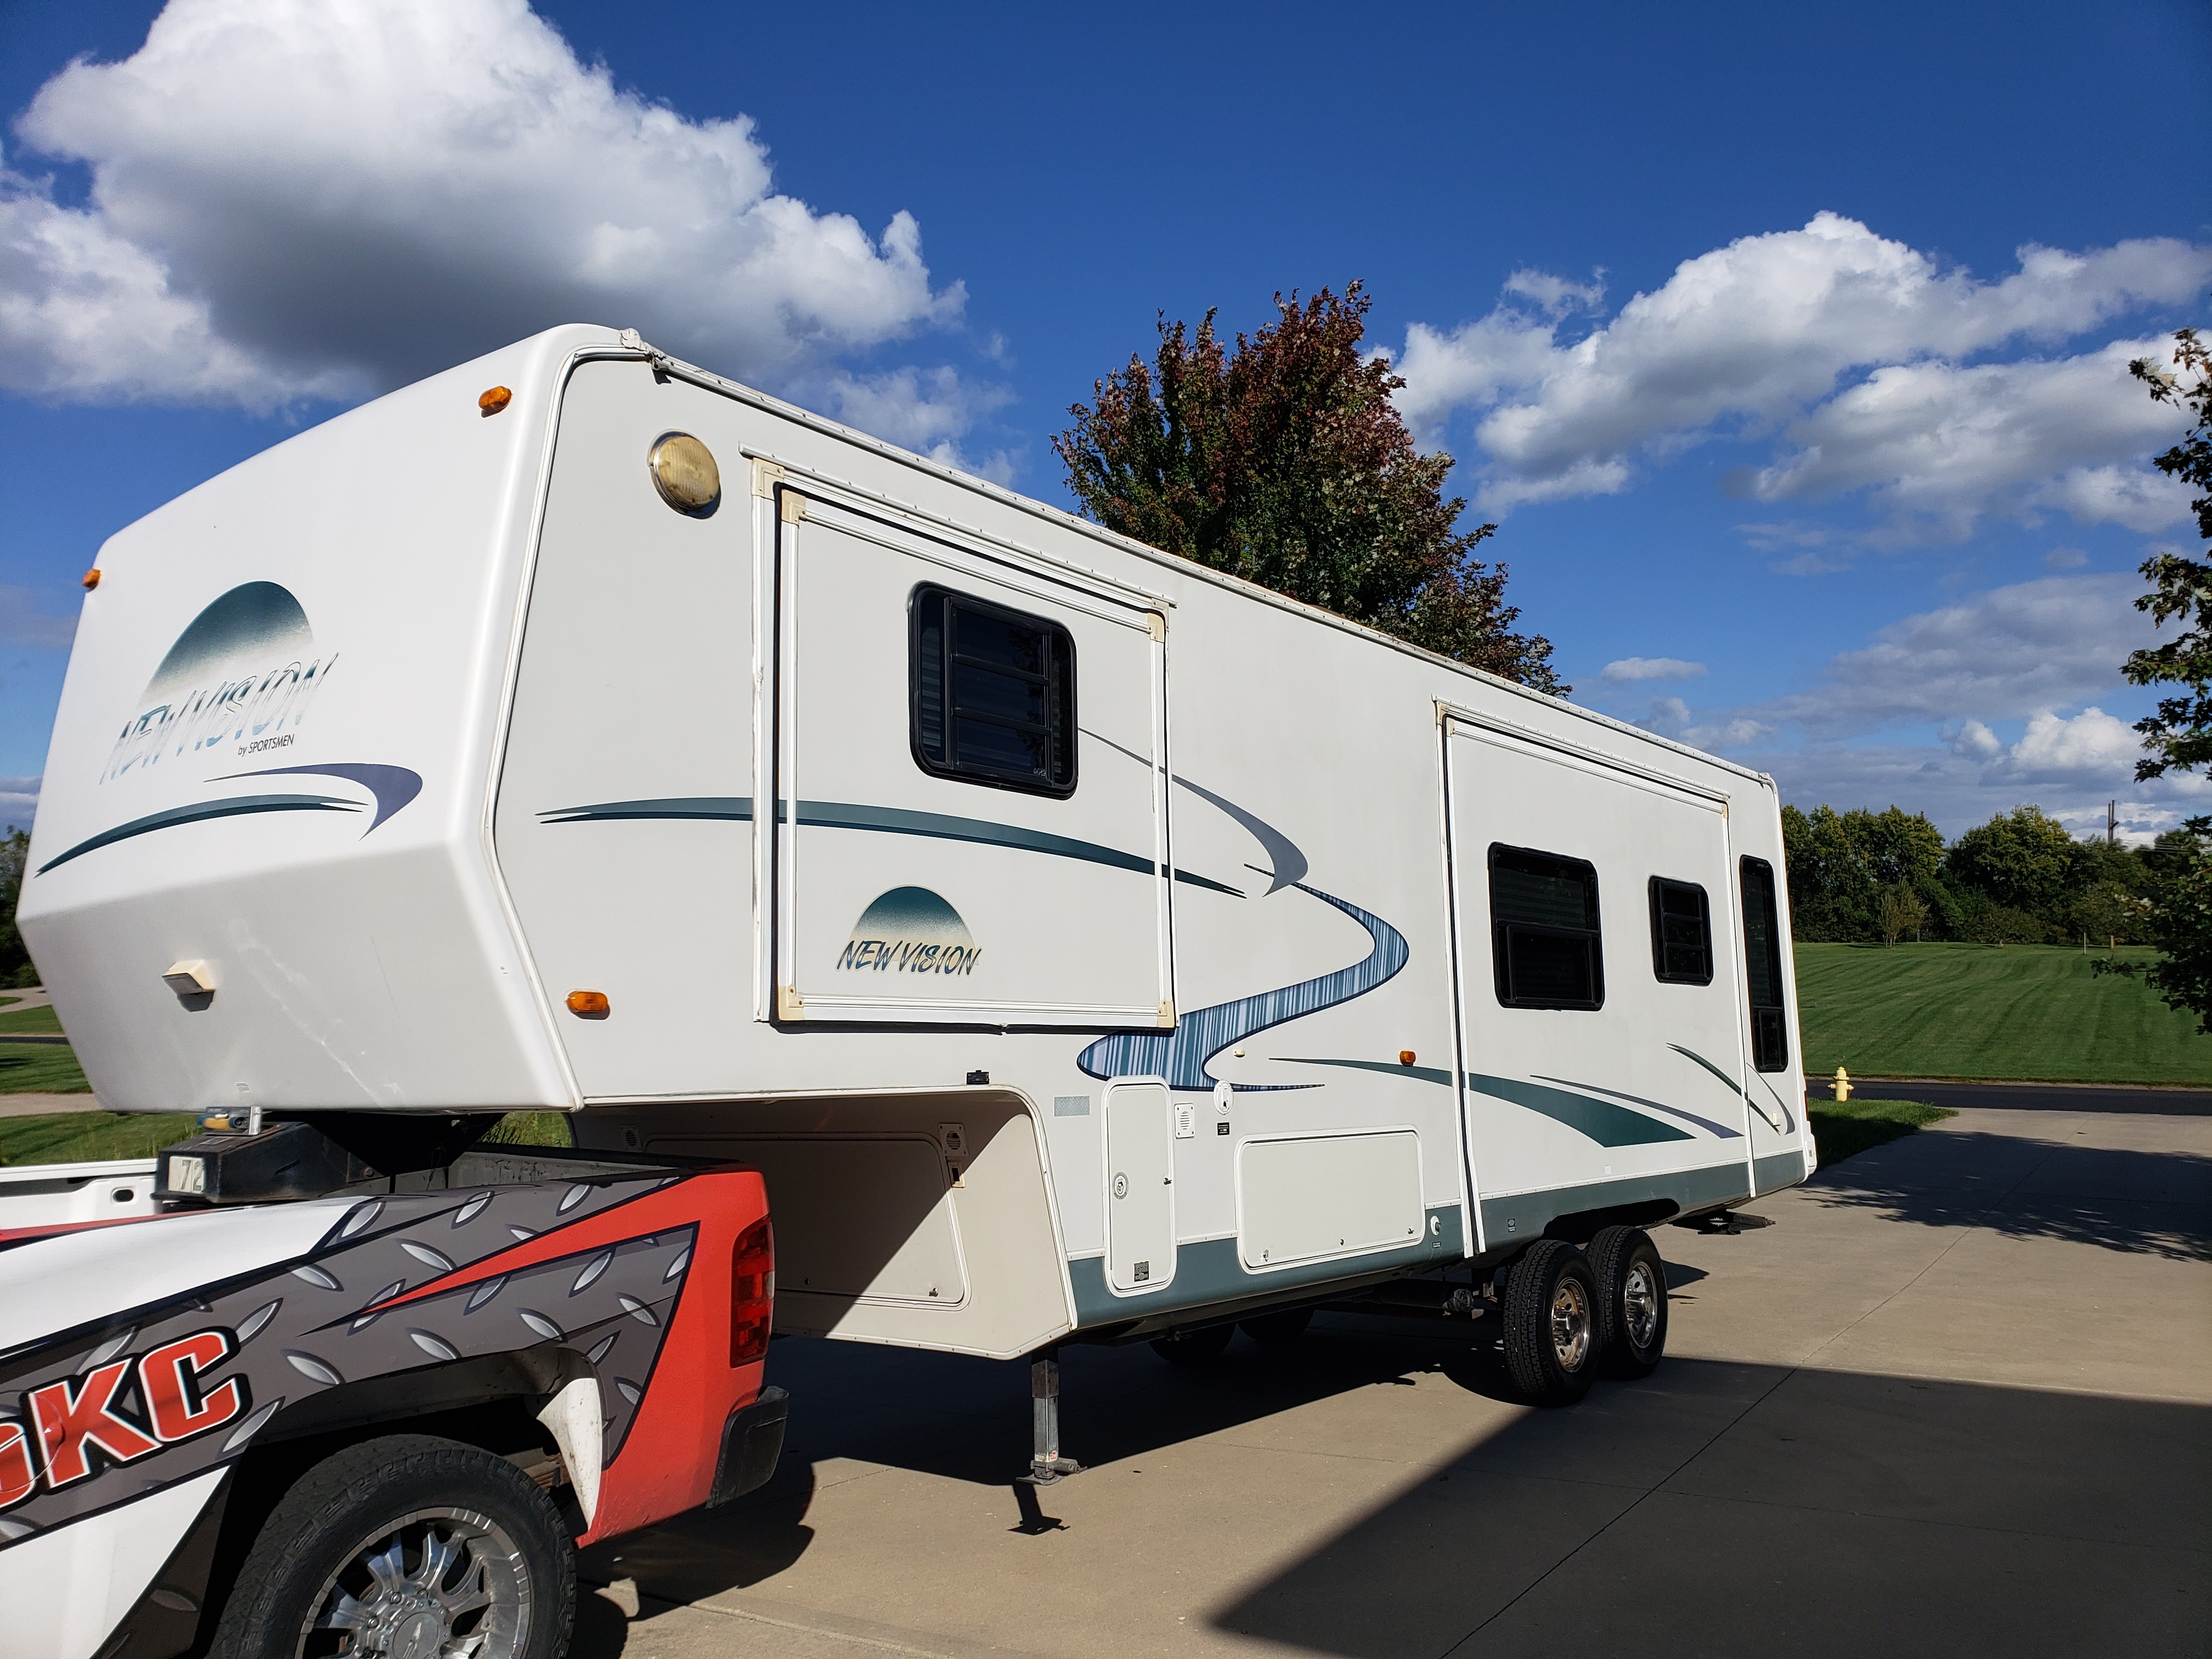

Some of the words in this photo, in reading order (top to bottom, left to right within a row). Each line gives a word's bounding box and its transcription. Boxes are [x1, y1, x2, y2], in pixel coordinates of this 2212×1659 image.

[99, 690, 196, 785] NEW
[176, 652, 338, 757] VISION
[238, 746, 247, 757] by
[248, 733, 295, 754] SPORTSMEN
[837, 940, 903, 971] NEW
[899, 942, 982, 976] VISION
[180, 1159, 203, 1191] 72
